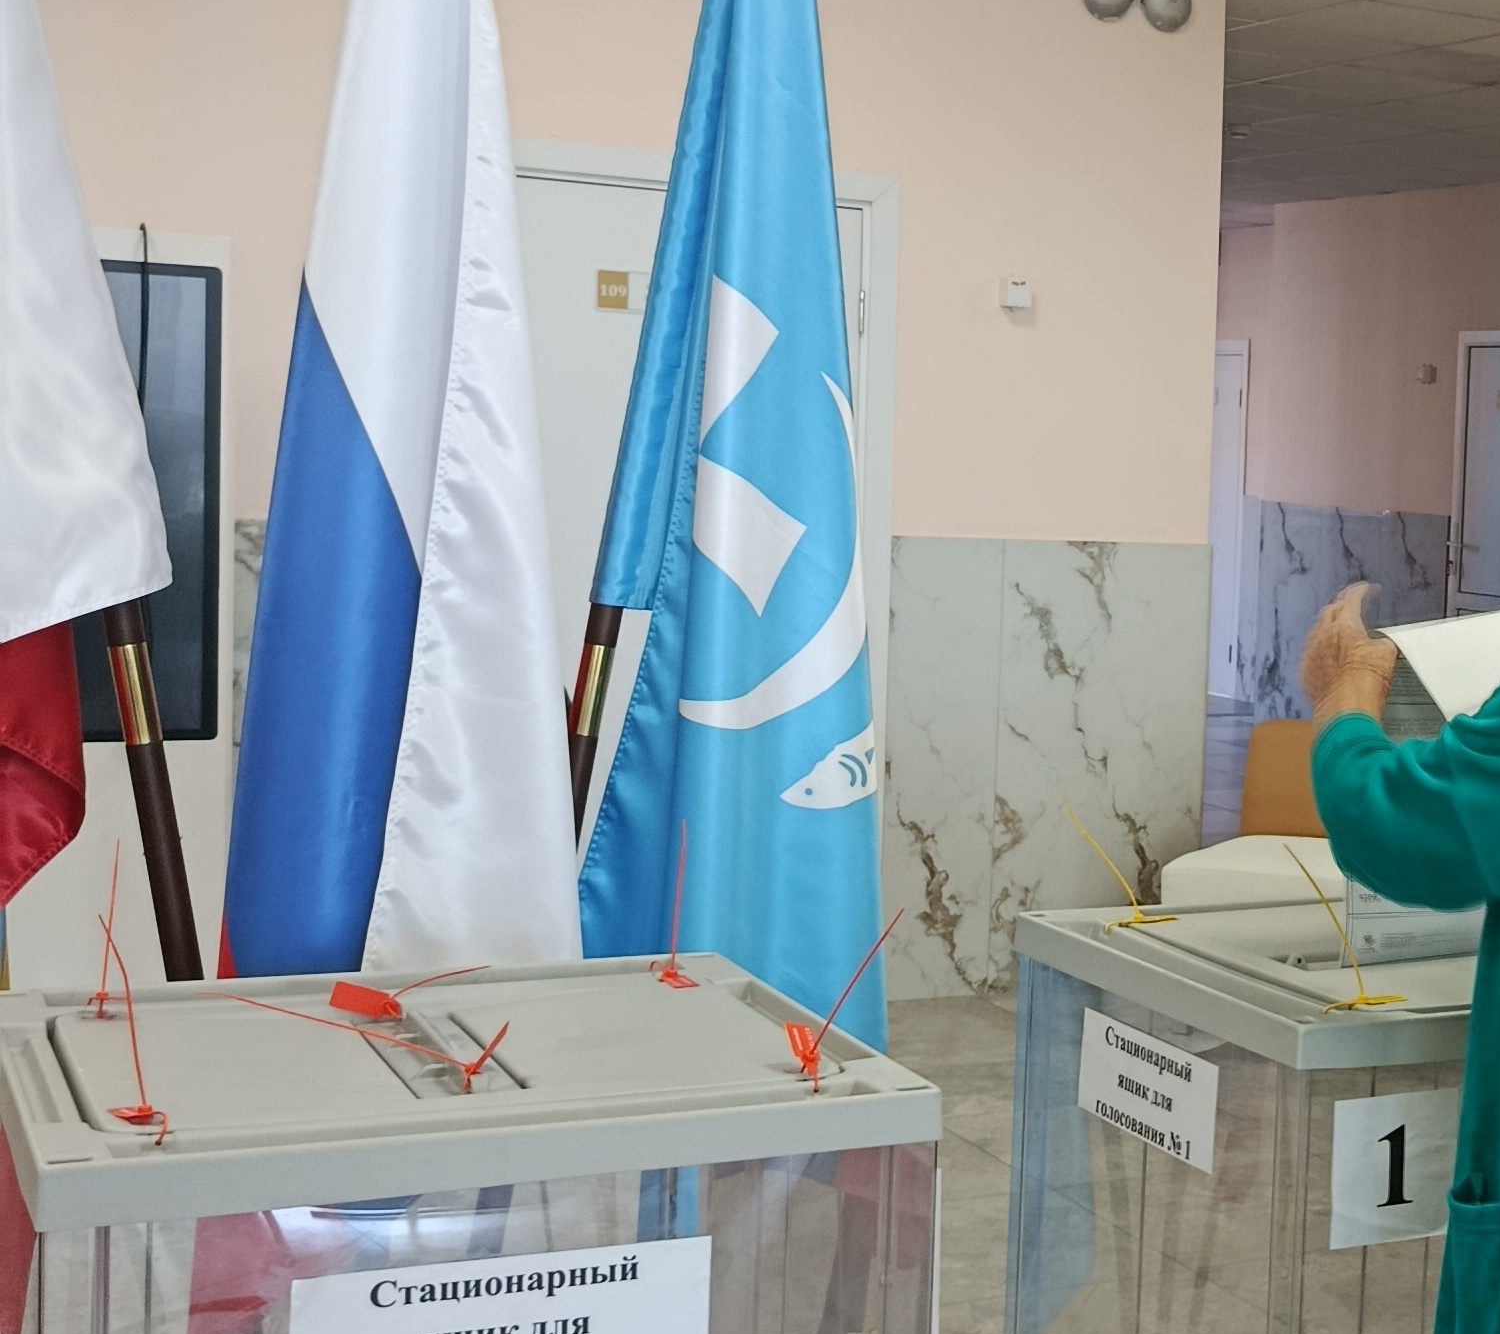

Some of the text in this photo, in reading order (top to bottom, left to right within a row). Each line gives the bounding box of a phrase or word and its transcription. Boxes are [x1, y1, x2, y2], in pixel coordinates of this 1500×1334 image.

[600, 284, 627, 297] 109
[1105, 1025, 1192, 1082] Стационарный
[1117, 1073, 1173, 1112] ящик для
[1095, 1099, 1191, 1160] голосования № 1
[1377, 1124, 1414, 1207] 1
[369, 1255, 640, 1309] Стационарный
